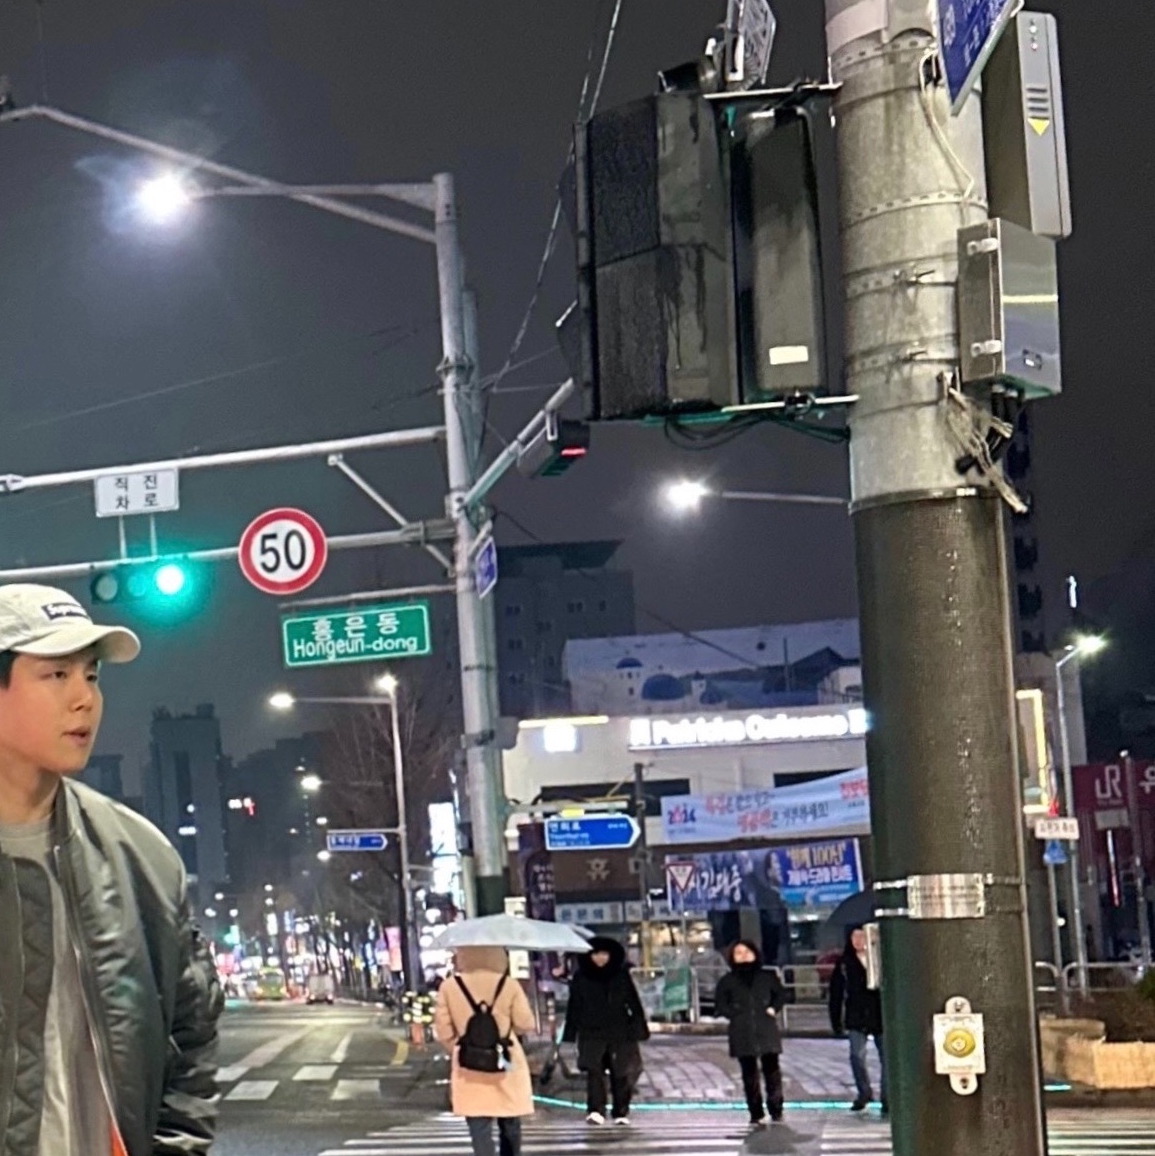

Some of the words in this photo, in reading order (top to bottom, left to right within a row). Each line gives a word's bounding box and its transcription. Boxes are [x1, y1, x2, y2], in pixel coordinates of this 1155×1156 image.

[114, 475, 158, 491] 직진
[115, 492, 159, 510] 차로
[260, 529, 307, 574] 50
[311, 612, 400, 642] 홍은동
[294, 635, 419, 661] Hongeun-dong
